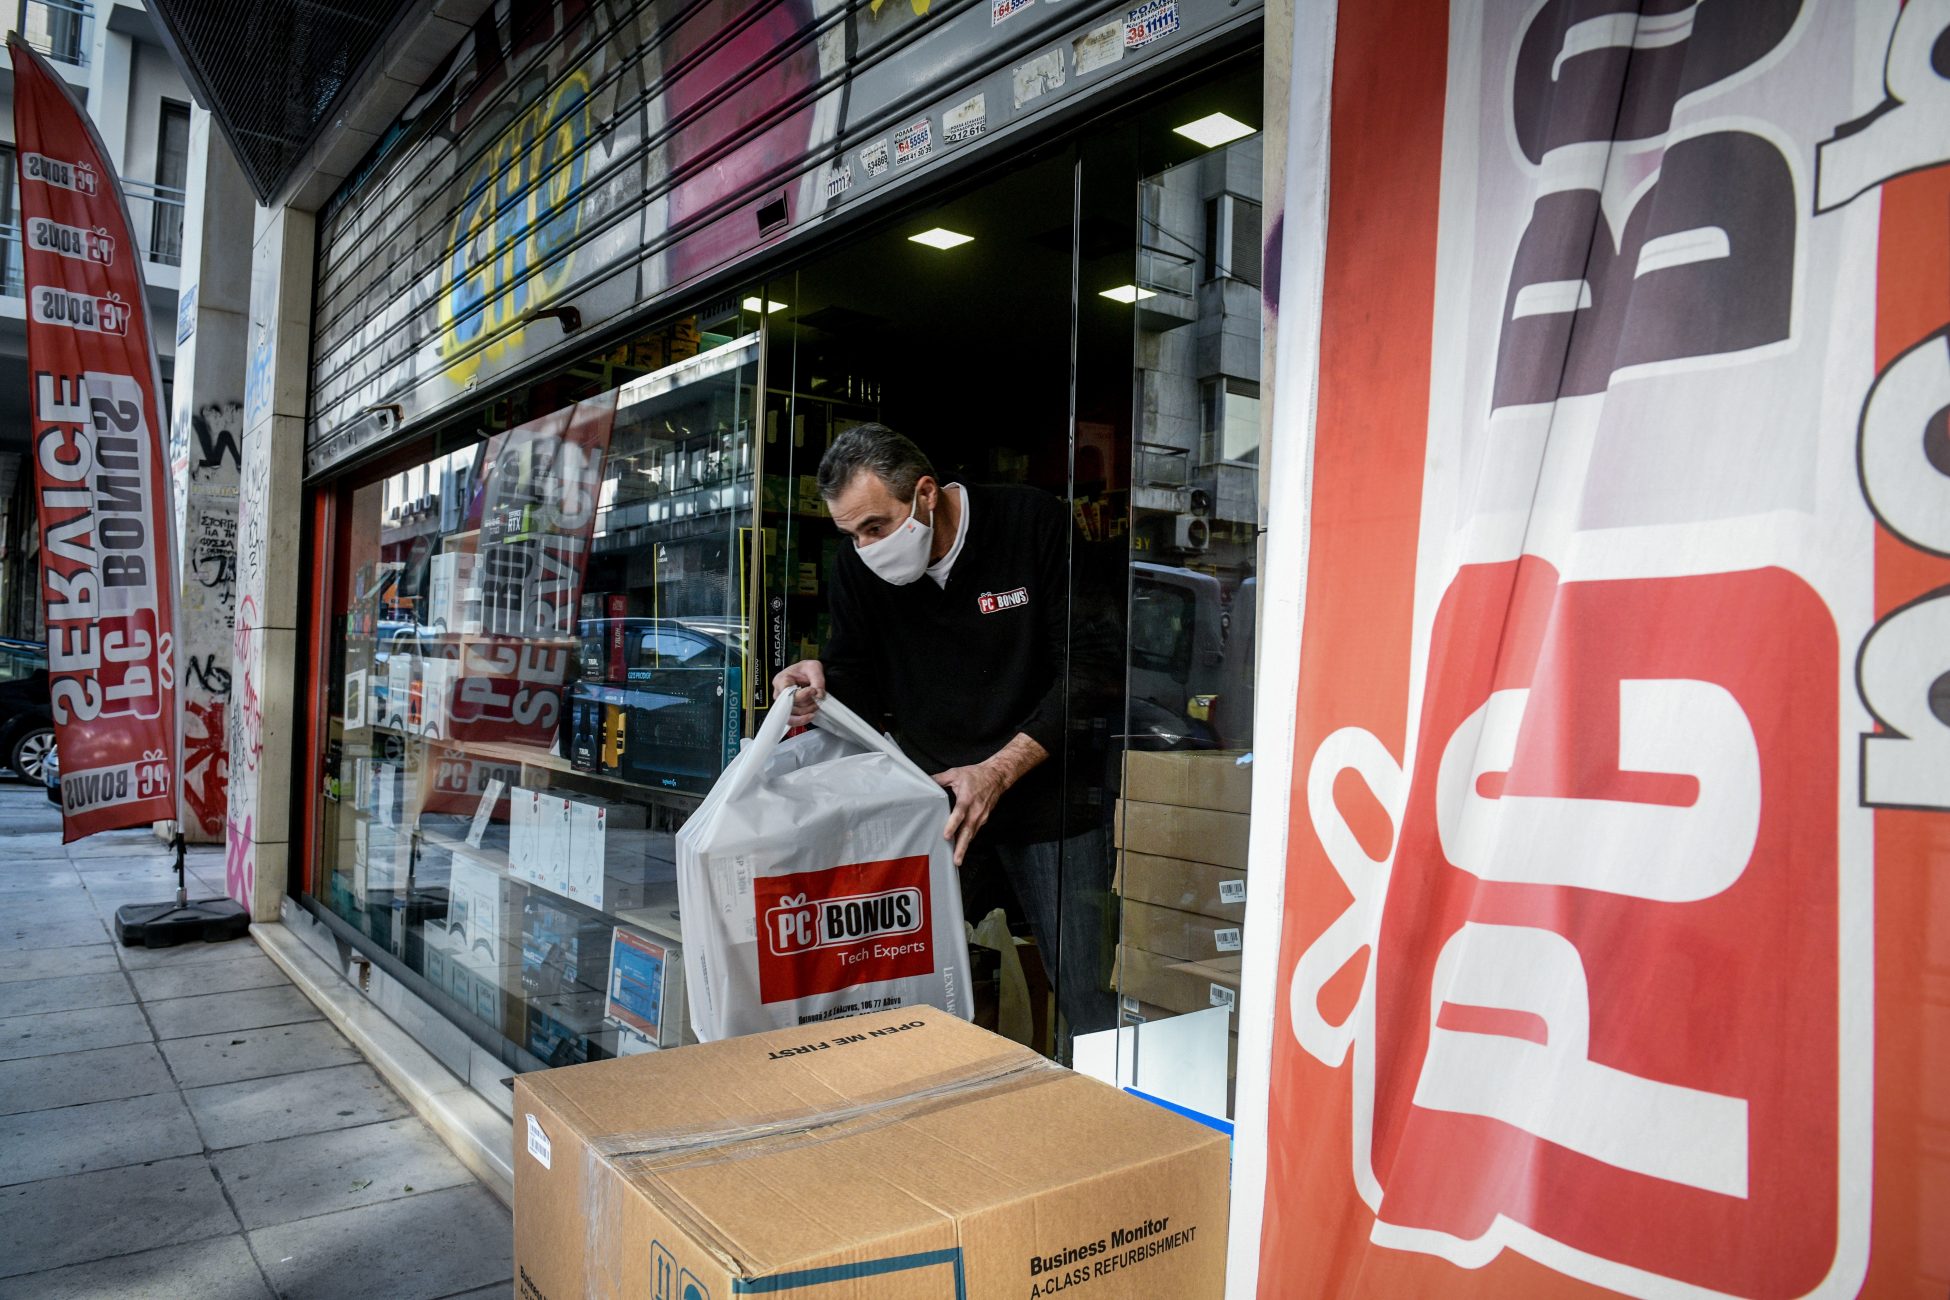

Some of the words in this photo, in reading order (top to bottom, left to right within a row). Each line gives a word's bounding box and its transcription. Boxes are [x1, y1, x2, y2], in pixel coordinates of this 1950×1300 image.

[1127, 24, 1145, 41] 38
[1146, 10, 1174, 33] 11111
[898, 142, 910, 153] 64
[507, 516, 521, 533] RTX
[981, 597, 994, 612] PC
[997, 590, 1026, 608] BONUS
[774, 615, 783, 667] SAGARA
[728, 689, 740, 745] PRODIGY
[437, 761, 466, 790] PC
[778, 910, 813, 949] PC
[826, 894, 912, 940] BONUS
[1412, 678, 1767, 1199] PC
[838, 946, 869, 967] Tech
[874, 941, 925, 961] Experts
[860, 1000, 873, 1010] 106
[873, 998, 882, 1008] 77
[831, 1034, 868, 1046] ME
[868, 1020, 926, 1038] OPEN
[768, 1041, 831, 1061] FIRST
[1030, 1239, 1107, 1277] Business
[1111, 1216, 1170, 1249] Monitor
[1030, 1266, 1091, 1300] A-CLASS
[1094, 1226, 1197, 1278] REFURBISHMENT
